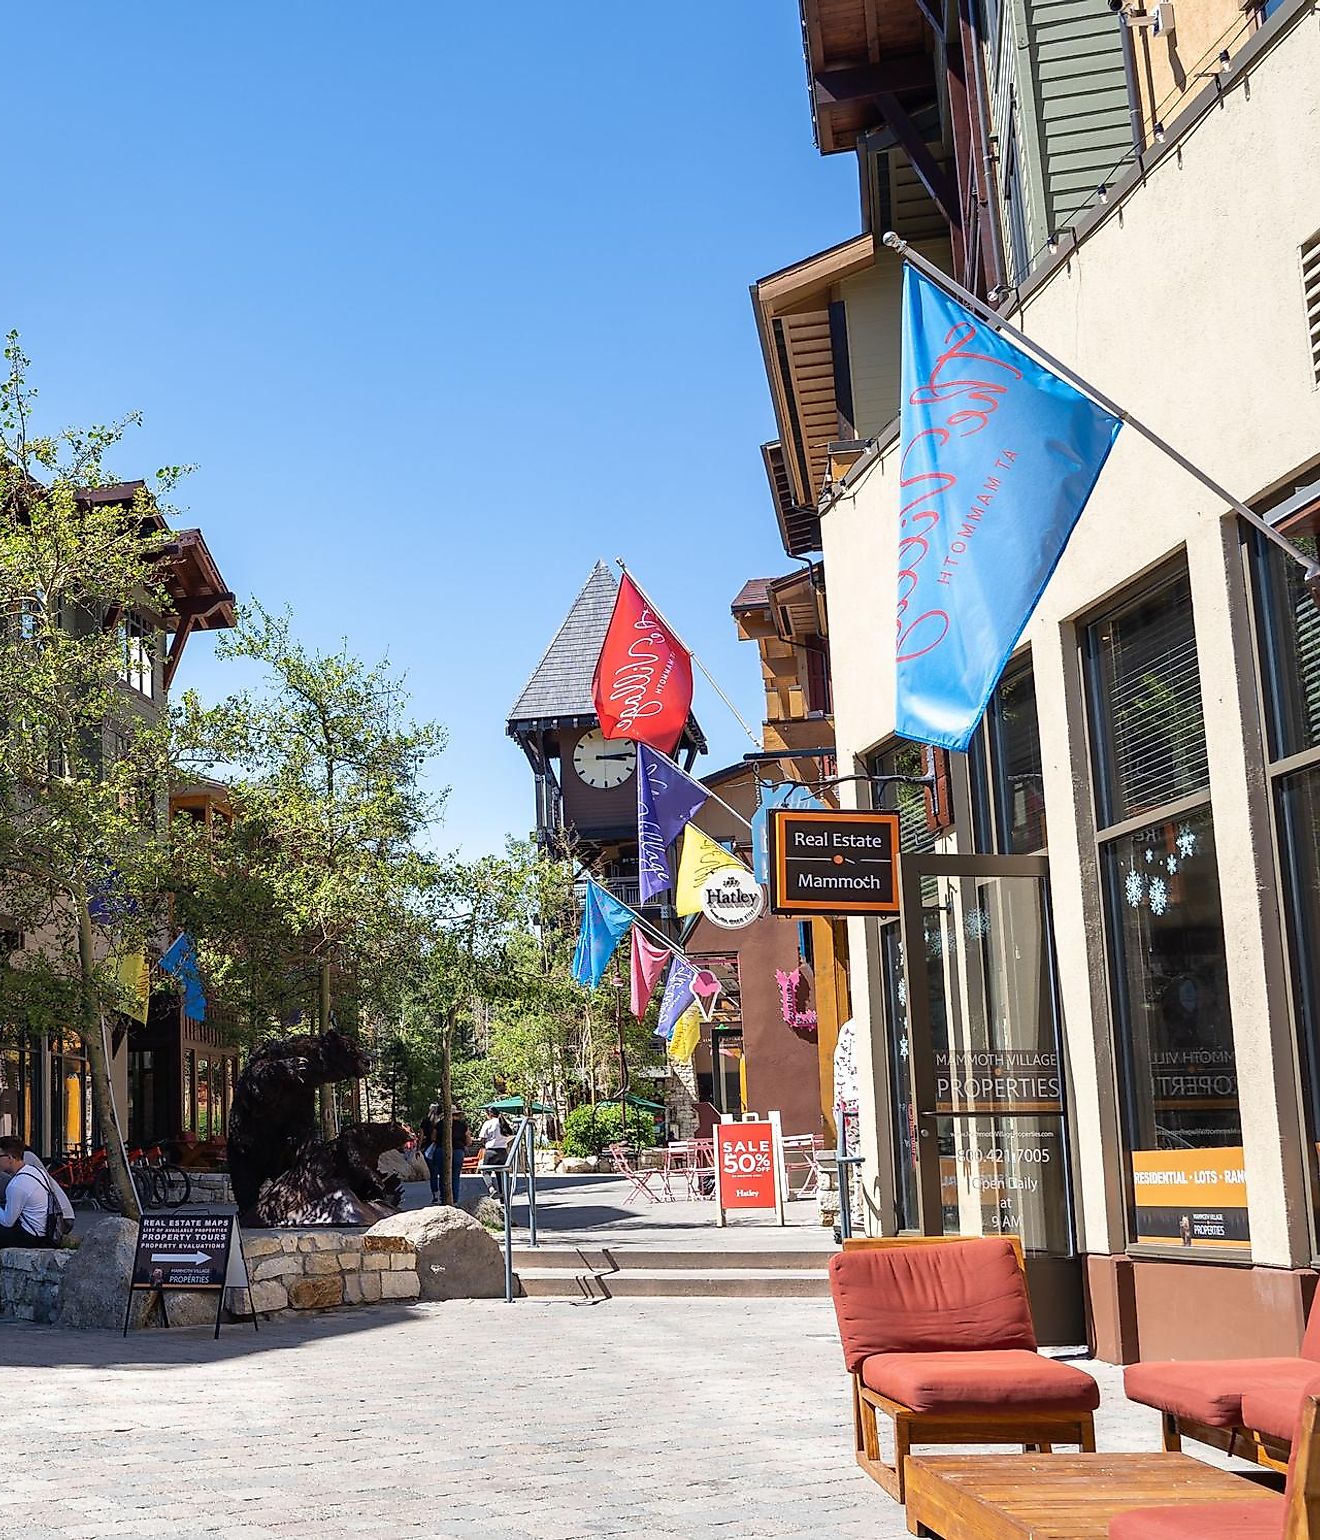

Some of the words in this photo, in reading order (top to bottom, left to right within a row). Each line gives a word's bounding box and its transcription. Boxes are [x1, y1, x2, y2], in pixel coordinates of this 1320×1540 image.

[794, 832, 829, 847] Real
[833, 833, 882, 848] Estate
[798, 873, 881, 890] Mammoth
[706, 888, 760, 908] Hatley
[936, 1053, 1004, 1066] MAMMOTH
[1007, 1054, 1058, 1066] VILLAGE
[937, 1078, 1060, 1098] PROPERTIES
[723, 1141, 770, 1153] SALE
[723, 1153, 771, 1173] 50%
[972, 1176, 1005, 1191] Open
[1008, 1176, 1038, 1192] Daily
[1134, 1171, 1188, 1185] RESIDENTIAL
[1194, 1171, 1217, 1184] LOTS
[1224, 1169, 1246, 1184] RAN
[1000, 1198, 1012, 1209] at
[991, 1216, 998, 1228] 9
[1002, 1216, 1023, 1228] AM
[142, 1233, 192, 1241] PROPERTY
[195, 1233, 226, 1241] TOURS
[1194, 1225, 1225, 1236] PROPERTIES
[169, 1275, 210, 1284] PROPERTIES
